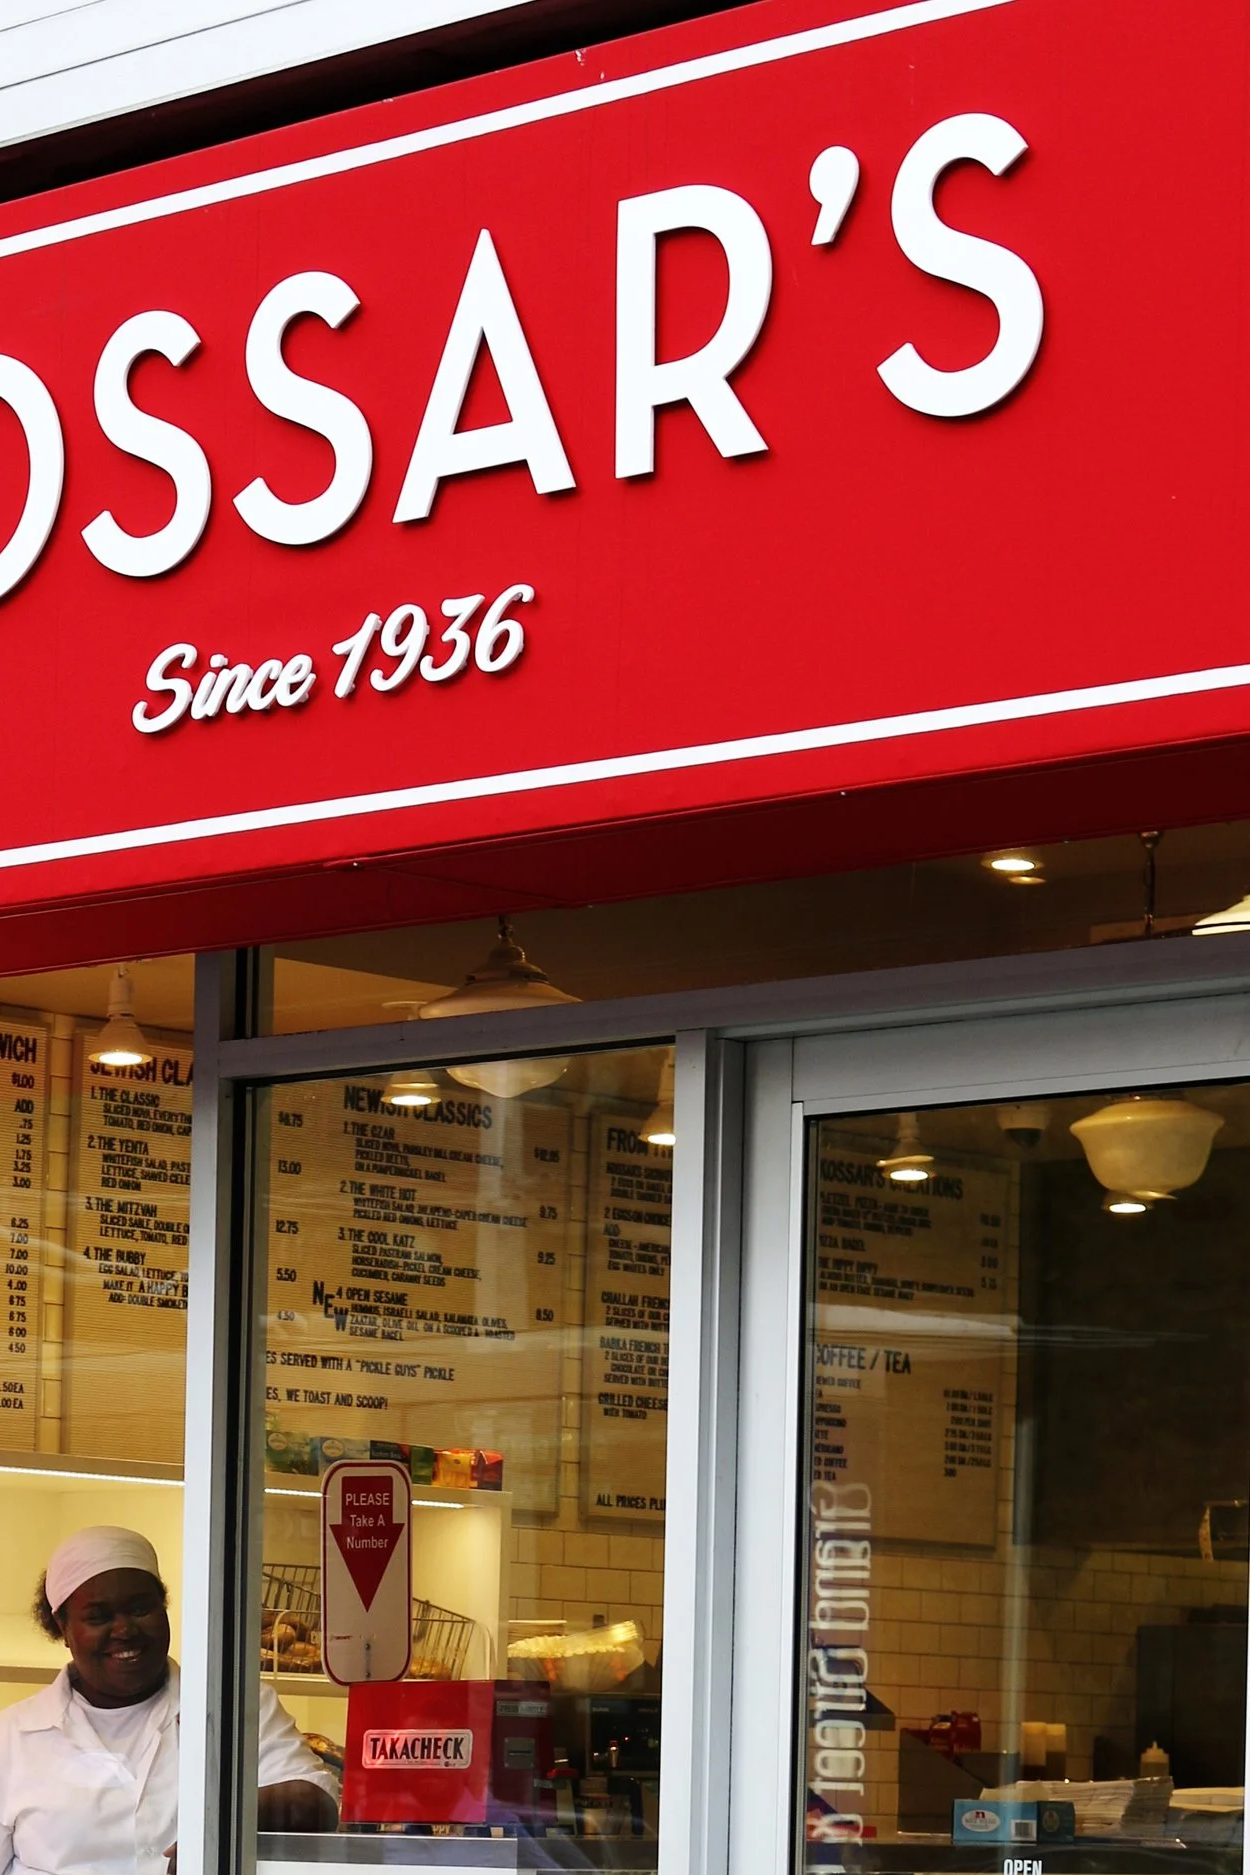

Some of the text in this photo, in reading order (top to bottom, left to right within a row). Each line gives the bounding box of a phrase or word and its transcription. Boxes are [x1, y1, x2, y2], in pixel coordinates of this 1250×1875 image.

[131, 583, 535, 736] Since 1936
[281, 1353, 318, 1368] SERVED
[321, 1355, 343, 1371] WITH
[884, 1350, 911, 1374] TEA
[286, 1388, 300, 1402] WE
[304, 1389, 331, 1405] TOAST
[334, 1393, 353, 1408] AND
[345, 1492, 391, 1507] PLEASE
[350, 1514, 386, 1528] Take A
[346, 1535, 389, 1550] Number
[369, 1735, 465, 1762] TAKACHECK
